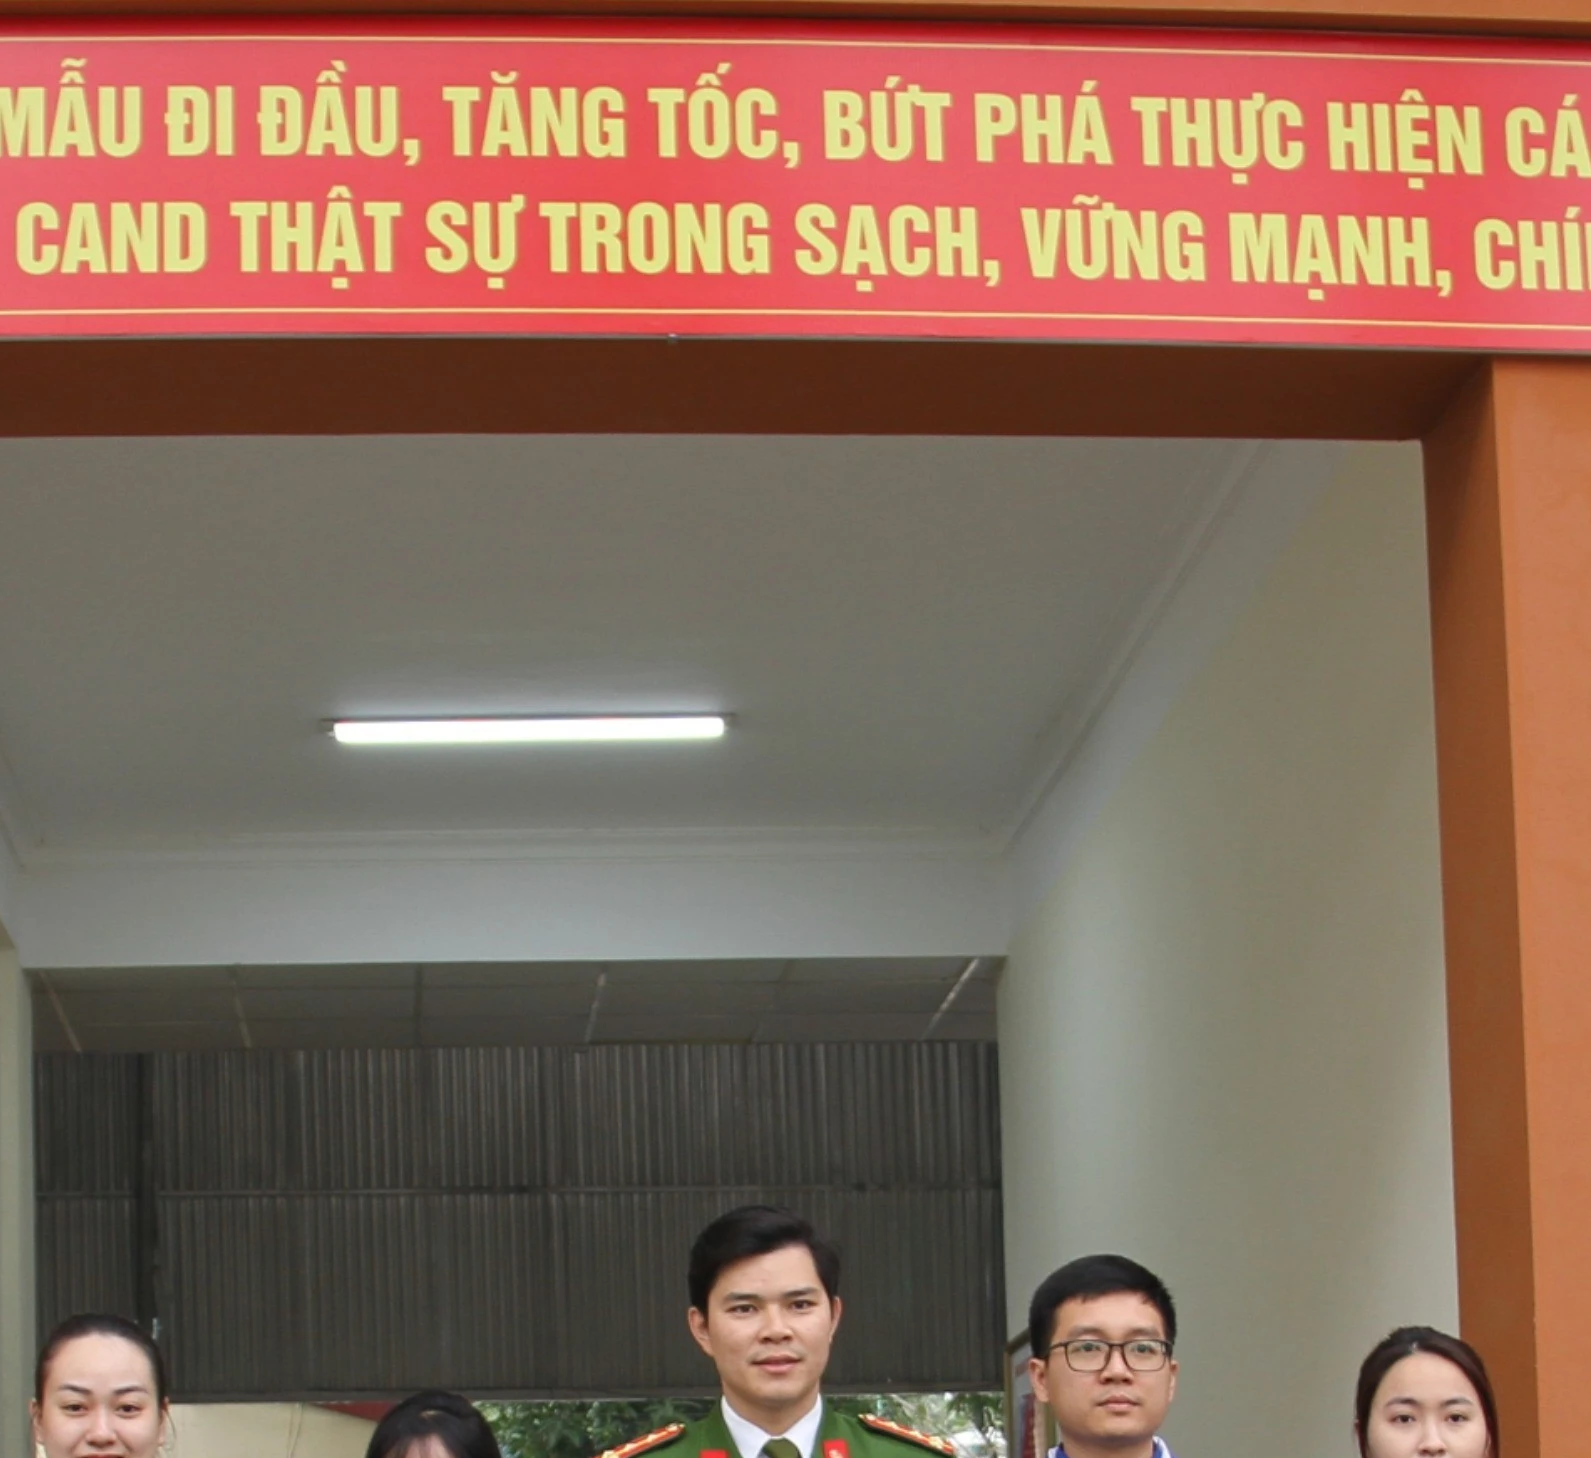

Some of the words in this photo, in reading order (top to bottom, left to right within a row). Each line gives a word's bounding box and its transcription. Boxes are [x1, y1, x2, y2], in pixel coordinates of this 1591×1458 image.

[164, 86, 234, 156] ĐI
[257, 58, 420, 166] ĐẦU,
[443, 72, 625, 158] TĂNG
[648, 63, 800, 168] TỐC,
[824, 76, 952, 161] BỨT
[975, 80, 1113, 165] PHÁ
[1131, 93, 1304, 185] THỰC
[1327, 89, 1483, 189] HIỆN
[16, 202, 207, 275] CAND
[230, 186, 402, 289] THẬT
[426, 194, 525, 289] SỰ
[540, 202, 770, 275] TRONG
[795, 203, 1000, 292] SẠCH,
[1021, 194, 1206, 282] VỮNG
[1229, 213, 1451, 300] MẠNH,
